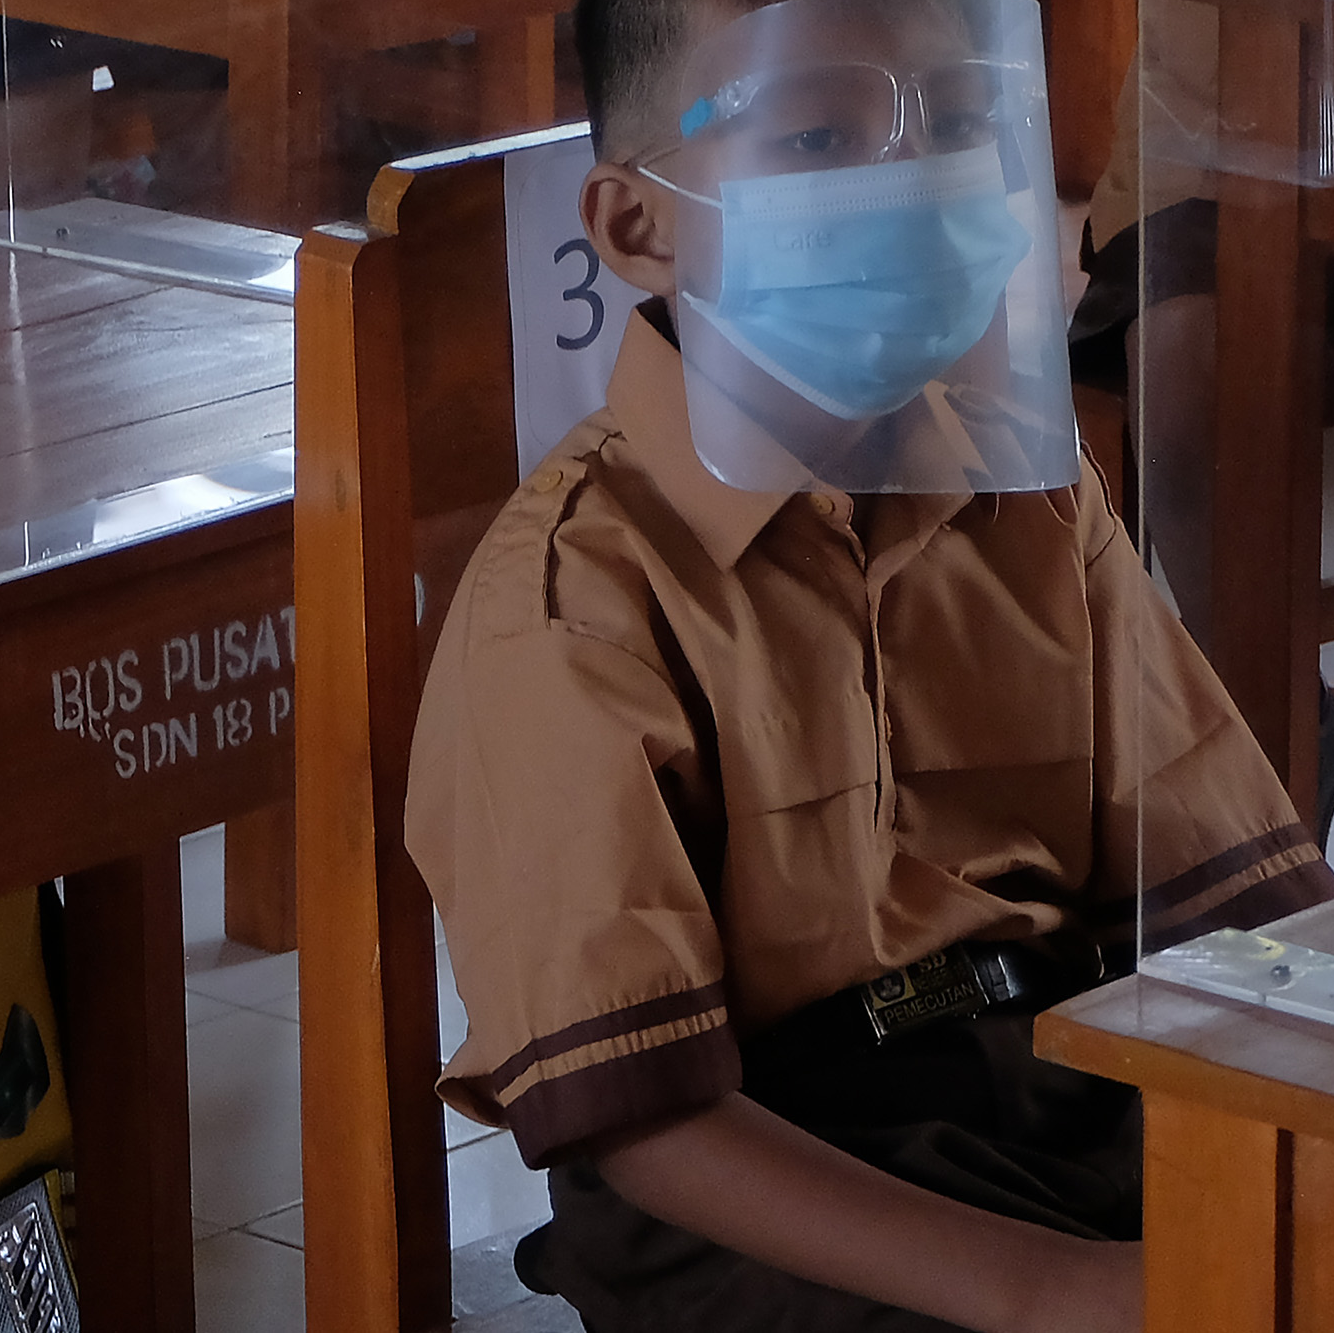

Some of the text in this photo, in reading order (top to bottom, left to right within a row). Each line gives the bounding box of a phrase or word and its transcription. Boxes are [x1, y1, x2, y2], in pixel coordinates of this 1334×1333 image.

[52, 649, 143, 733] BOS
[113, 712, 198, 779] SDN
[213, 697, 253, 751] 18
[883, 980, 975, 1025] PEMECUTAN
